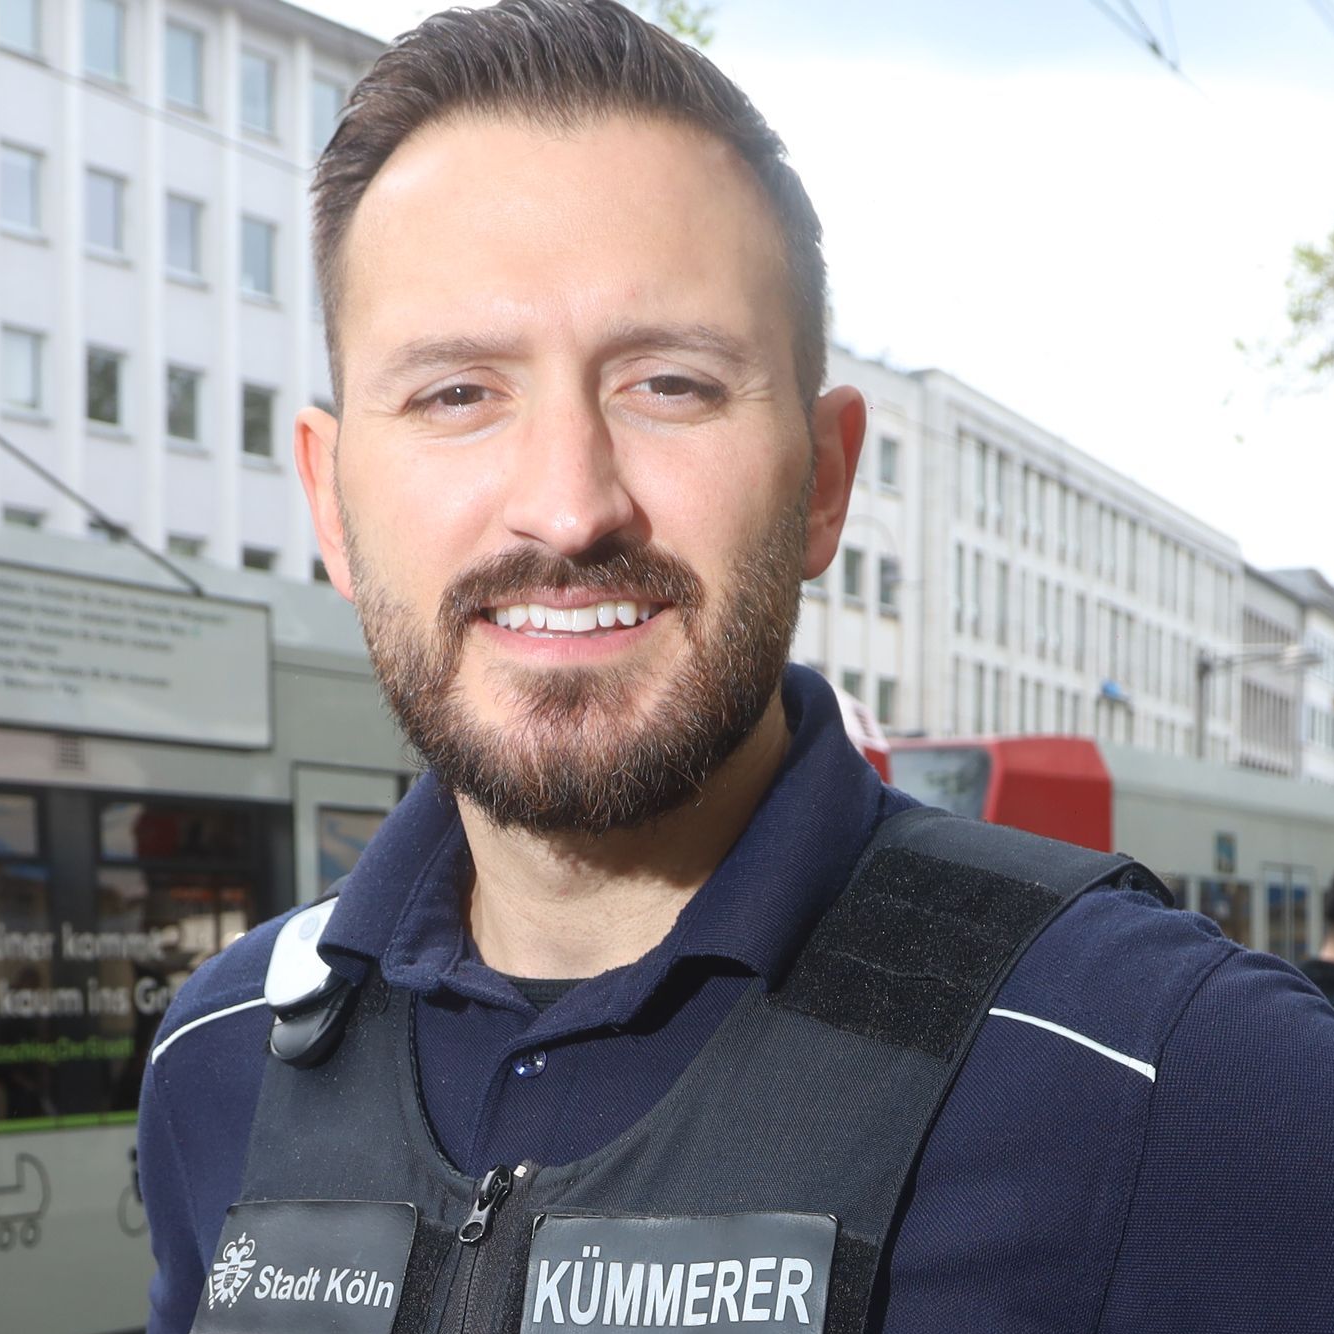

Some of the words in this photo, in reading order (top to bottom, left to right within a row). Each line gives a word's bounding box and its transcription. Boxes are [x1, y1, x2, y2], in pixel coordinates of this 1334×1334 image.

[87, 977, 130, 1016] ins
[134, 976, 172, 1016] Gr
[254, 1264, 321, 1302] Stadt
[324, 1267, 395, 1309] Köln
[532, 1245, 814, 1327] KÜMMERER
